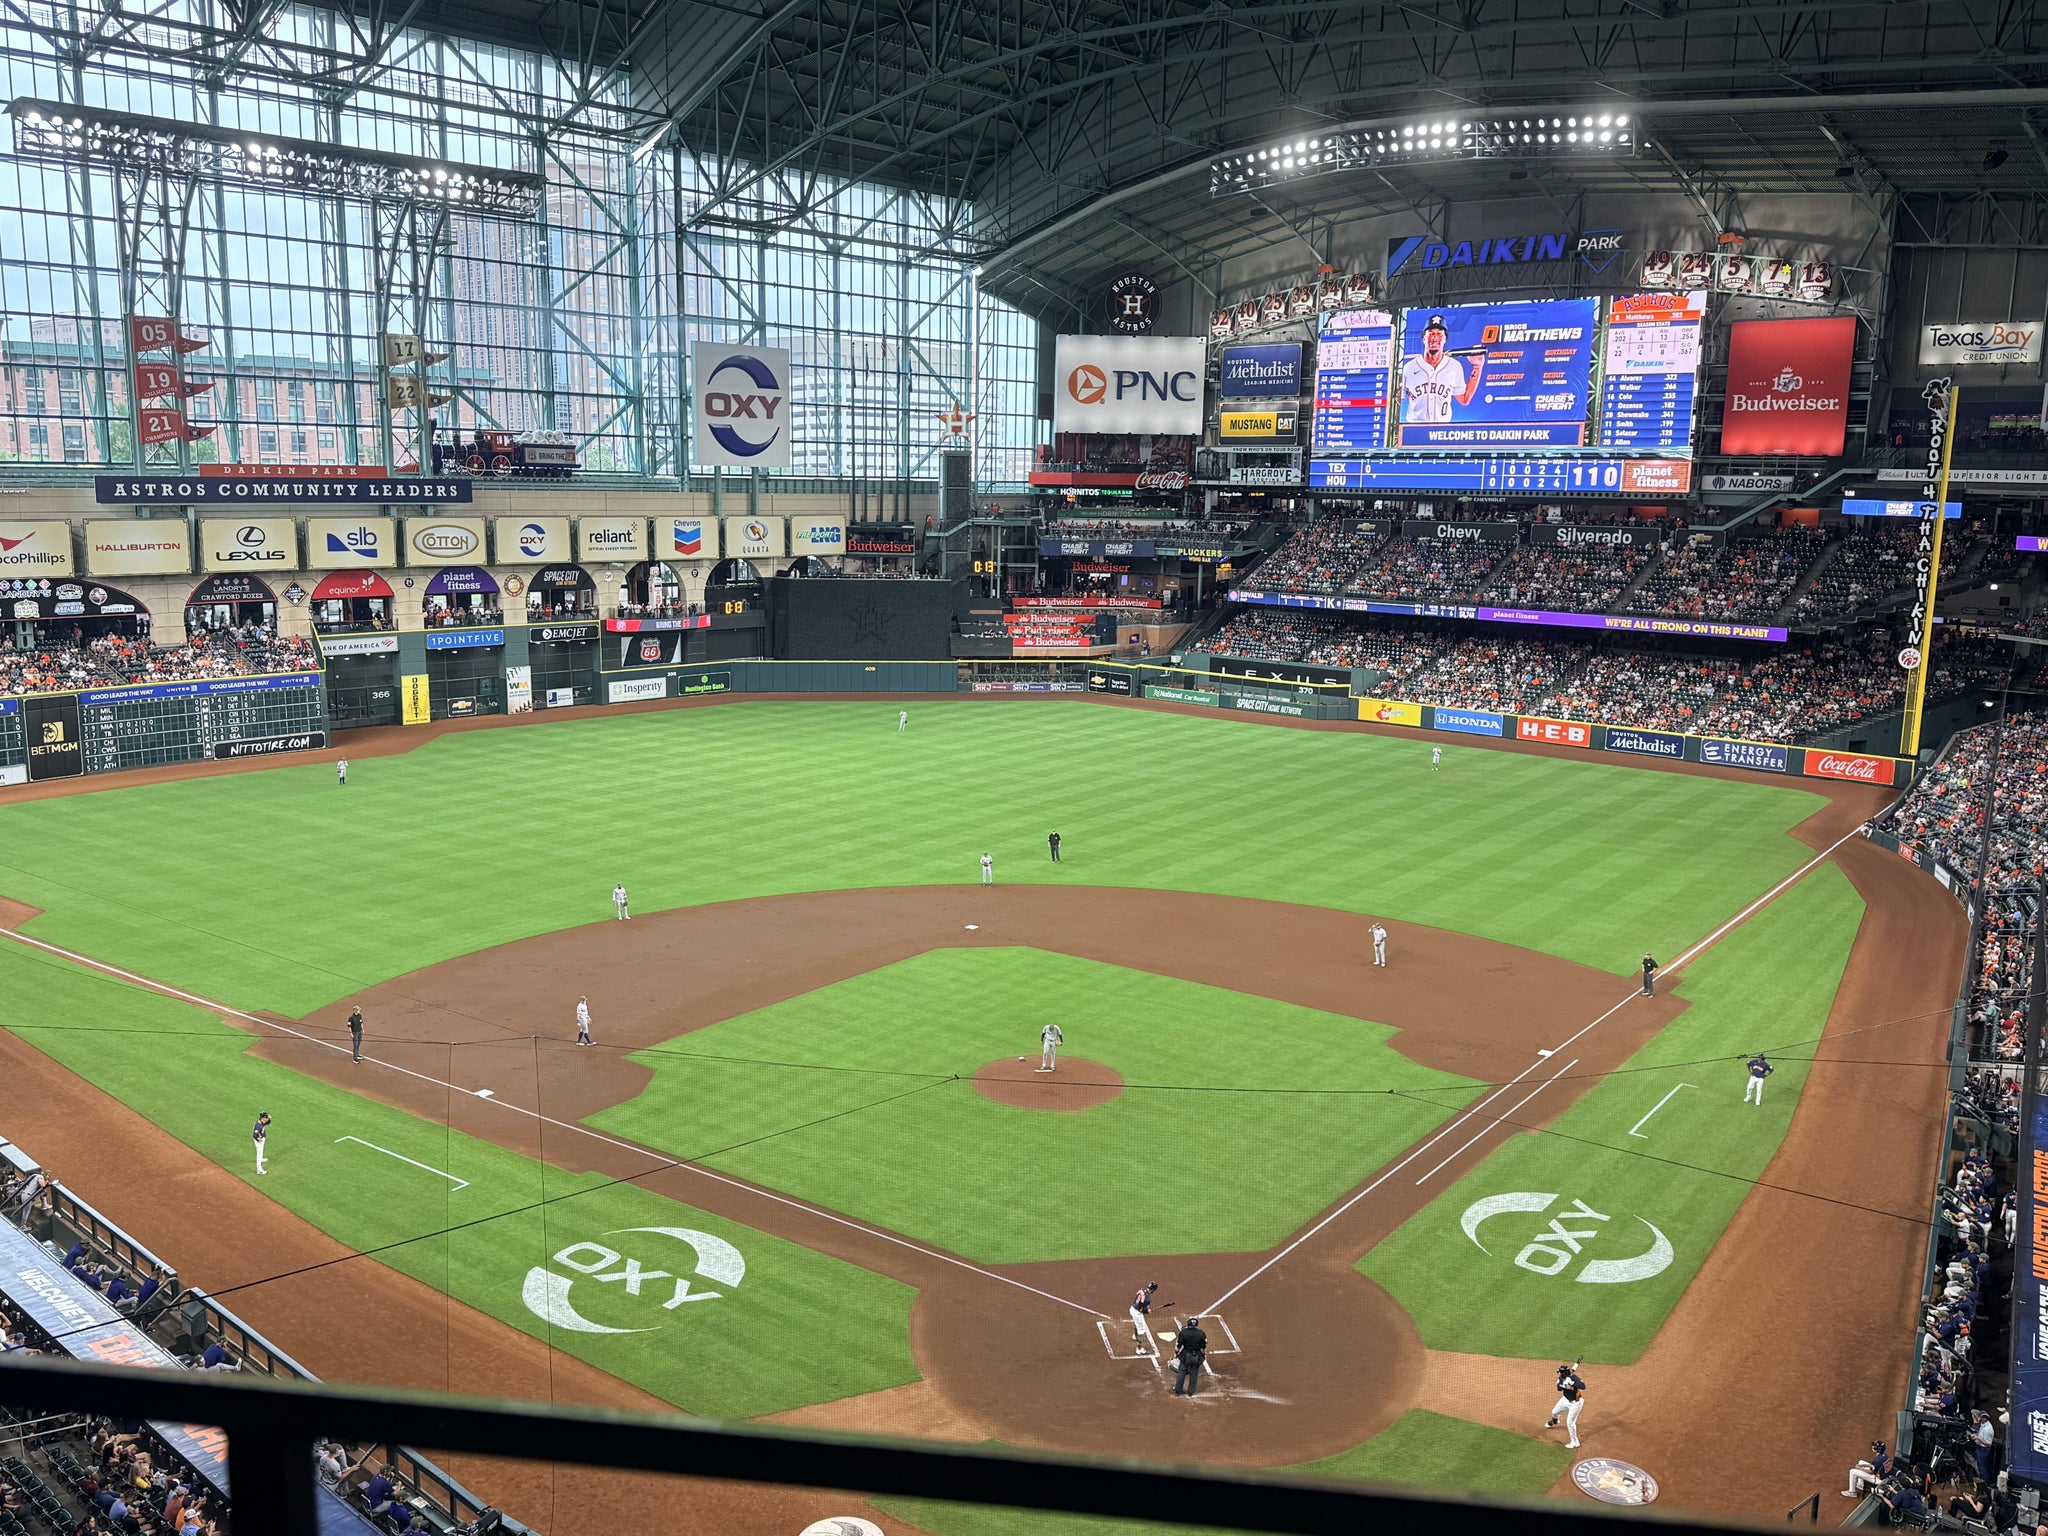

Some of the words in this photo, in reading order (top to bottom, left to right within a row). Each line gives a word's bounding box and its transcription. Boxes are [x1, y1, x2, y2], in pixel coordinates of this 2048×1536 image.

[1422, 234, 1568, 268] DAIKIN
[1578, 234, 1624, 251] PARK
[1645, 251, 1671, 270] 49
[1682, 253, 1709, 273] 24
[1729, 256, 1741, 276] 5
[1769, 259, 1782, 280] 7
[1803, 262, 1830, 283] 13
[1112, 276, 1155, 293] HOUSTON
[1320, 280, 1340, 297] 34
[1291, 286, 1311, 302] 33
[1123, 295, 1143, 314] H
[1237, 301, 1254, 318] 40
[1264, 294, 1283, 311] 25
[1624, 294, 1677, 311] ASTROS
[1113, 317, 1151, 331] ASTROS
[1211, 309, 1229, 326] 32
[142, 324, 167, 341] 05
[1503, 328, 1582, 342] MATTHEWS
[1930, 328, 1984, 347] Texas
[1992, 326, 2034, 350] Bay
[394, 342, 414, 357] 17
[1963, 353, 1993, 361] CREDIT
[1997, 352, 2028, 360] UNION
[1227, 361, 1294, 379] Methodist
[147, 372, 170, 389] 19
[1113, 370, 1196, 401] PNC
[396, 386, 415, 399] 22
[1408, 382, 1451, 401] ASTROS
[705, 392, 782, 420] OXY
[1731, 394, 1840, 411] Budweiser
[149, 416, 171, 432] 21
[1230, 419, 1272, 430] MUSTANG
[1278, 418, 1294, 430] CAT
[1429, 430, 1475, 440] WELCOME
[1476, 430, 1488, 440] TO
[1490, 430, 1523, 440] DAIKIN
[1524, 430, 1549, 439] PARK
[1927, 419, 1944, 478] ROOT
[224, 466, 296, 475] DAIKIN
[312, 467, 358, 475] PARK
[1328, 463, 1346, 473] TEX
[1632, 466, 1672, 478] planet
[1241, 469, 1292, 482] HARGROVE
[1326, 475, 1346, 486] HOU
[1572, 467, 1582, 486] 1
[1587, 467, 1597, 486] 1
[1604, 467, 1618, 487] 0
[1636, 476, 1679, 487] fitness
[114, 483, 206, 496] ASTROS
[218, 484, 358, 496] COMMUNITY
[369, 484, 458, 497] LEADERS
[1728, 478, 1781, 489] NABORS
[1060, 488, 1100, 496] HORNITOS
[1923, 484, 1935, 500] 4
[674, 519, 701, 527] Chevron
[1919, 506, 1937, 551] THA
[347, 527, 377, 546] slb
[589, 529, 632, 543] reliant
[811, 527, 841, 543] LNG
[1437, 524, 1481, 540] Chevy
[1557, 528, 1632, 545] Silverado
[421, 532, 469, 550] COTTON
[520, 536, 544, 544] OXY
[847, 539, 914, 552] Budweiser
[95, 543, 181, 552] HALLIBURTON
[1178, 549, 1223, 557] PLUCKERS
[216, 551, 285, 561] LEXUS
[1072, 561, 1131, 573] Budweiser
[443, 572, 474, 583] planet
[544, 571, 565, 581] SPACE
[565, 570, 580, 580] CITY
[329, 586, 359, 595] equinor
[447, 580, 481, 590] fitness
[1039, 598, 1084, 606] Budweiser
[1109, 598, 1150, 607] Budweiser
[1908, 558, 1929, 645] CHIKIN
[1031, 615, 1075, 623] Budweiser
[1493, 611, 1515, 619] planet
[1515, 612, 1539, 620] fitness
[1605, 618, 1632, 628] WE'RE
[1633, 619, 1650, 629] ALL
[1652, 621, 1690, 632] STRONG
[1692, 623, 1708, 633] ON
[1710, 625, 1731, 635] THIS
[1733, 626, 1769, 638] PLANET
[432, 633, 500, 645] 1POINTFIVE
[553, 628, 587, 638] EMCJET
[1035, 638, 1080, 646] Budweiser
[644, 648, 657, 657] 66
[509, 682, 529, 690] WM
[624, 681, 662, 694] Insperity
[685, 684, 712, 692] Huntington
[1298, 687, 1313, 695] 370
[372, 691, 390, 699] 366
[1160, 690, 1182, 699] National
[1237, 698, 1254, 709] SPACE
[1255, 700, 1268, 711] CITY
[1449, 716, 1501, 729] HONDA
[1522, 721, 1585, 742] H-E-B
[31, 742, 78, 756] BETMGM
[230, 736, 310, 755] NITTOTIRE.COM
[1611, 736, 1678, 754] Methodist
[1725, 743, 1773, 757] ENERGY
[1723, 753, 1784, 769] TRANSFER
[1514, 1198, 1611, 1276] OXY
[552, 1241, 724, 1310] OXY
[16, 1268, 89, 1318] WELCOME
